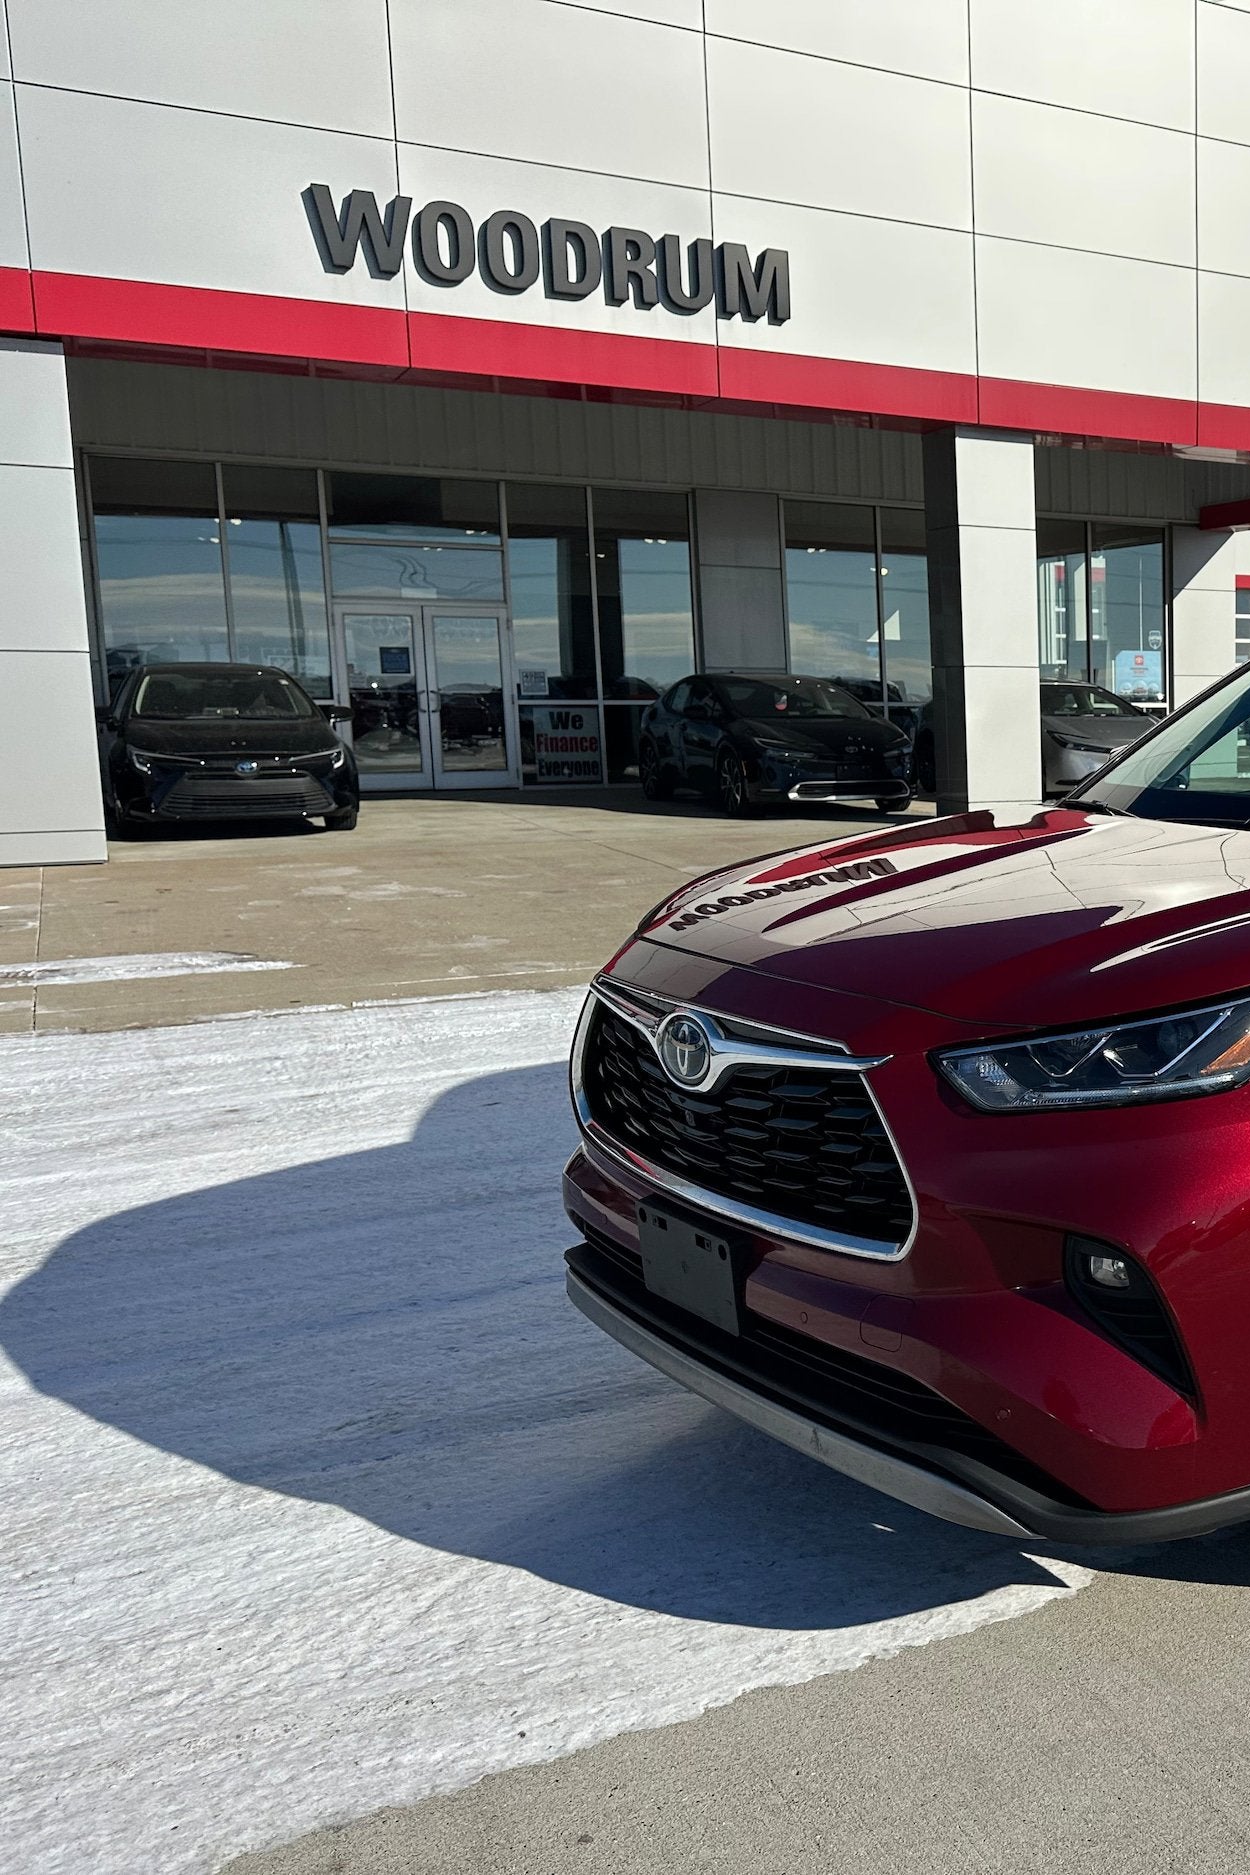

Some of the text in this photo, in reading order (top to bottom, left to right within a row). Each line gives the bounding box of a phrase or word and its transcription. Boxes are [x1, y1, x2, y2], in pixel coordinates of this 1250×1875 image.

[301, 183, 791, 326] WOODRUM
[548, 711, 584, 730] We
[536, 733, 598, 753] Finance
[538, 760, 600, 777] Everyone
